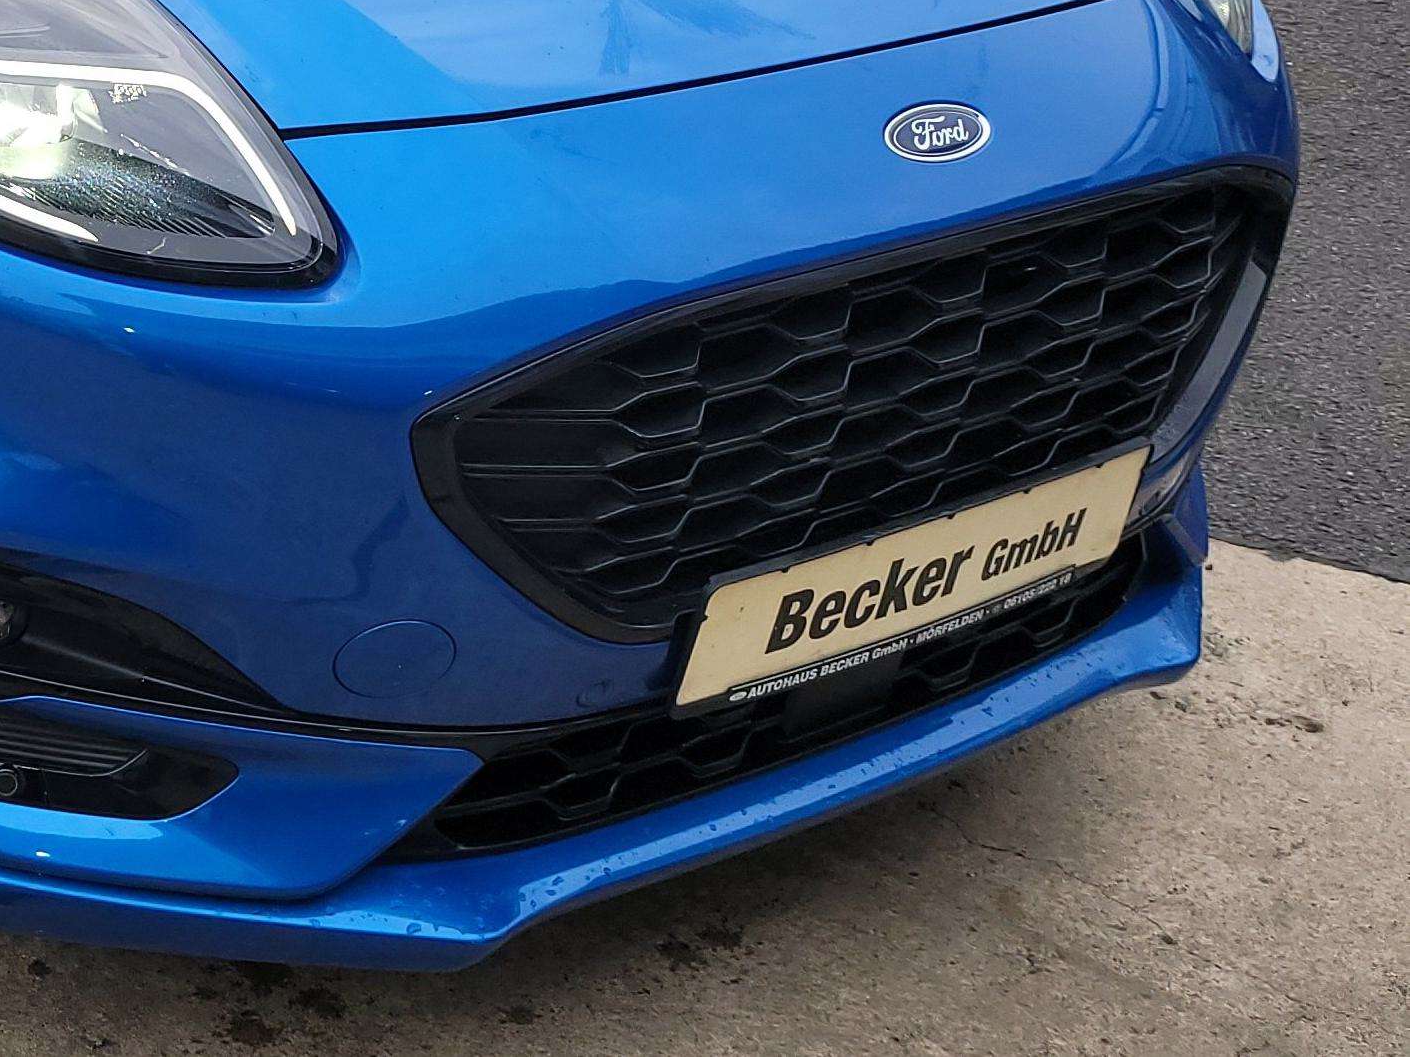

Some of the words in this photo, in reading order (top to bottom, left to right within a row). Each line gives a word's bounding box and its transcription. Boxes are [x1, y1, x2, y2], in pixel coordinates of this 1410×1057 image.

[911, 115, 969, 150] Ford
[764, 544, 976, 655] Becker
[981, 508, 1088, 582] GmbH
[747, 668, 819, 699] AUTOHAUS
[819, 651, 869, 678] BECKER
[871, 638, 909, 660] GmbH
